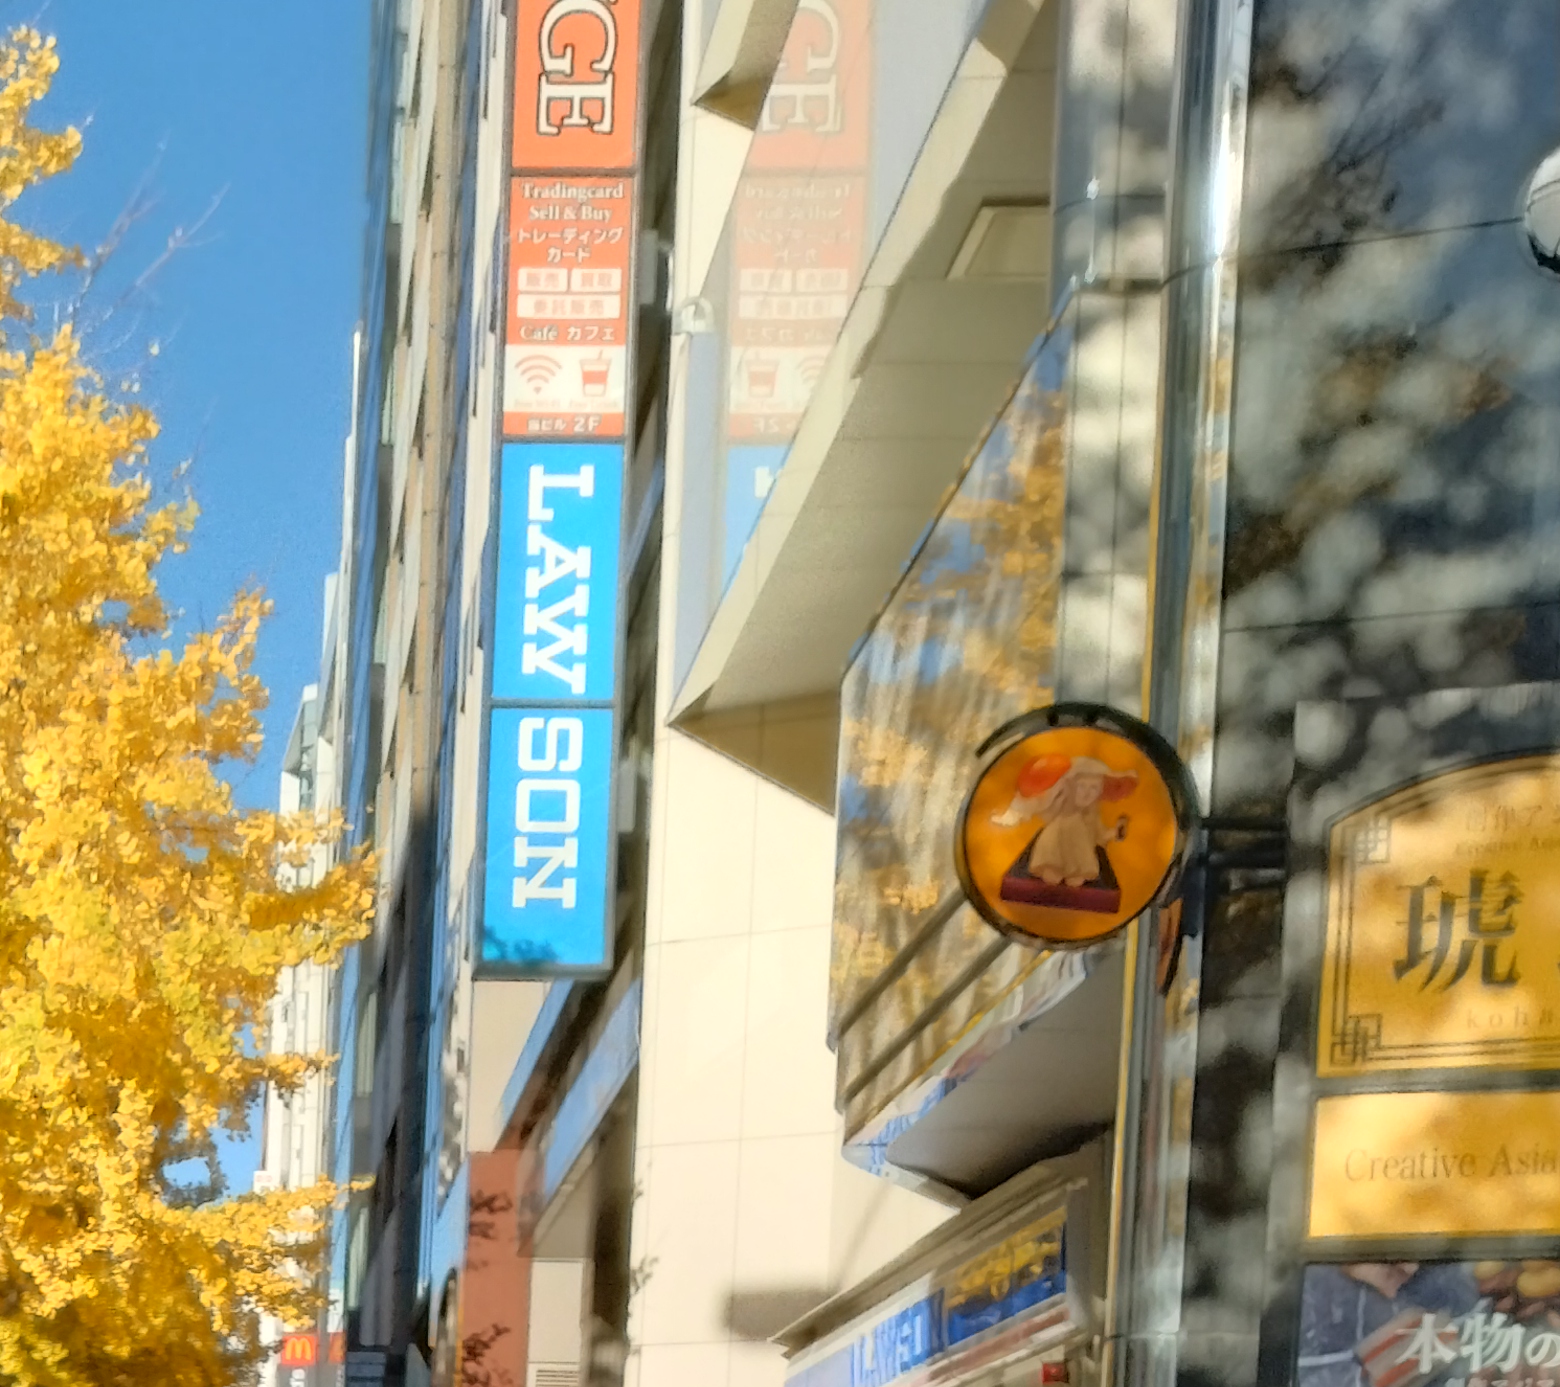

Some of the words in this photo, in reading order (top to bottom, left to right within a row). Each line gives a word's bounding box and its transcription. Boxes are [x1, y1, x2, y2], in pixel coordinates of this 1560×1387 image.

[523, 181, 625, 203] Tradingcard
[529, 204, 560, 221] Sell
[563, 205, 578, 220] &
[581, 204, 612, 224] Buy
[518, 227, 624, 245] トレーディング
[547, 246, 591, 264] カード
[566, 325, 616, 341] カフェ
[573, 413, 601, 433] 2F
[512, 464, 595, 909] LAWSON
[1345, 1145, 1476, 1184] Creative
[1393, 1312, 1560, 1375] 本物の
